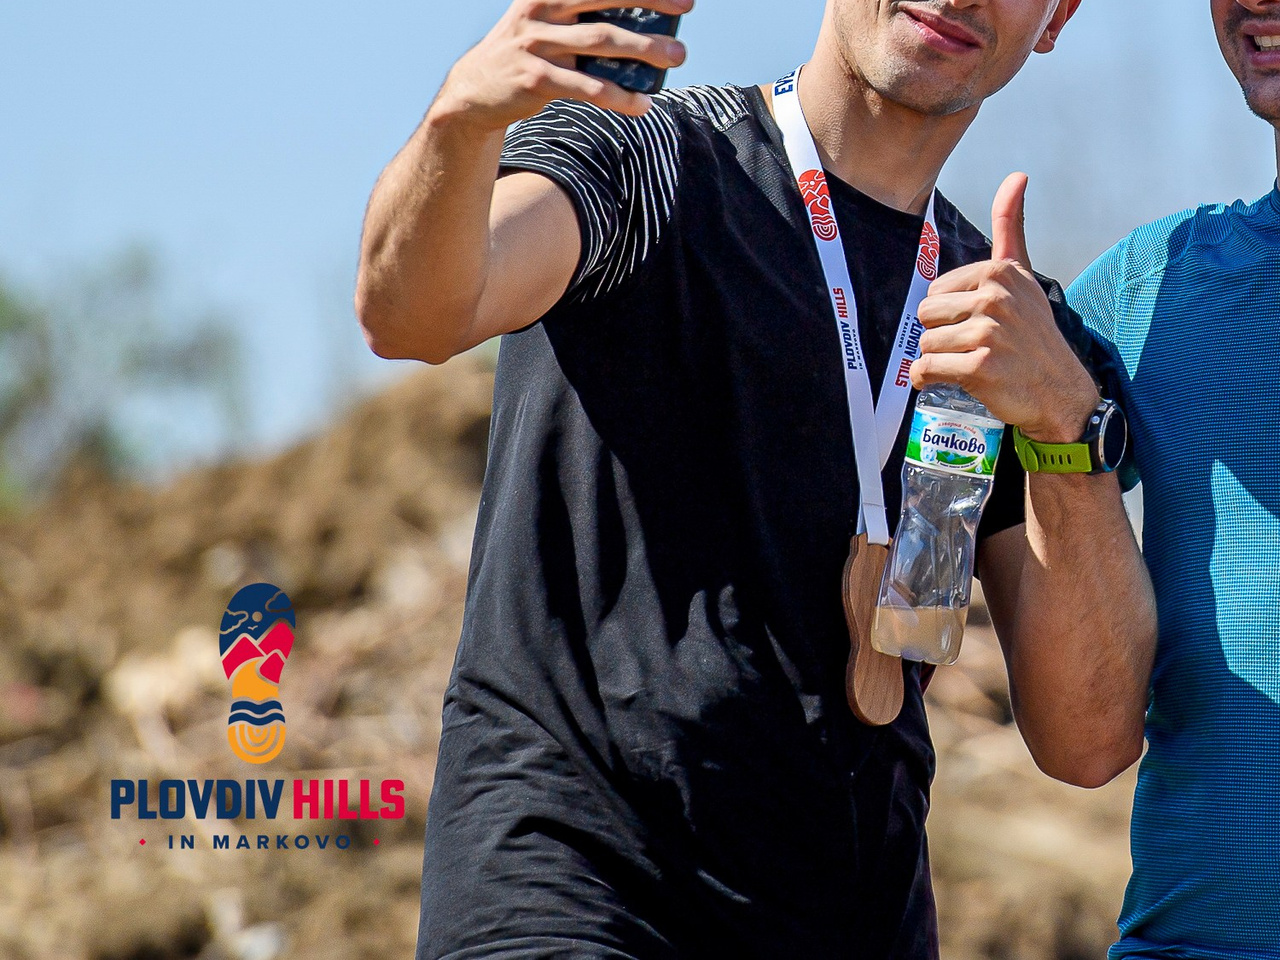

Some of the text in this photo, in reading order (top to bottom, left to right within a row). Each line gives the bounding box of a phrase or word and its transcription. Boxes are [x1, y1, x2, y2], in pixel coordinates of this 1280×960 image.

[833, 287, 858, 370] PLOVDIV HILLS
[895, 358, 913, 388] HILLS
[922, 428, 985, 454] Бачково
